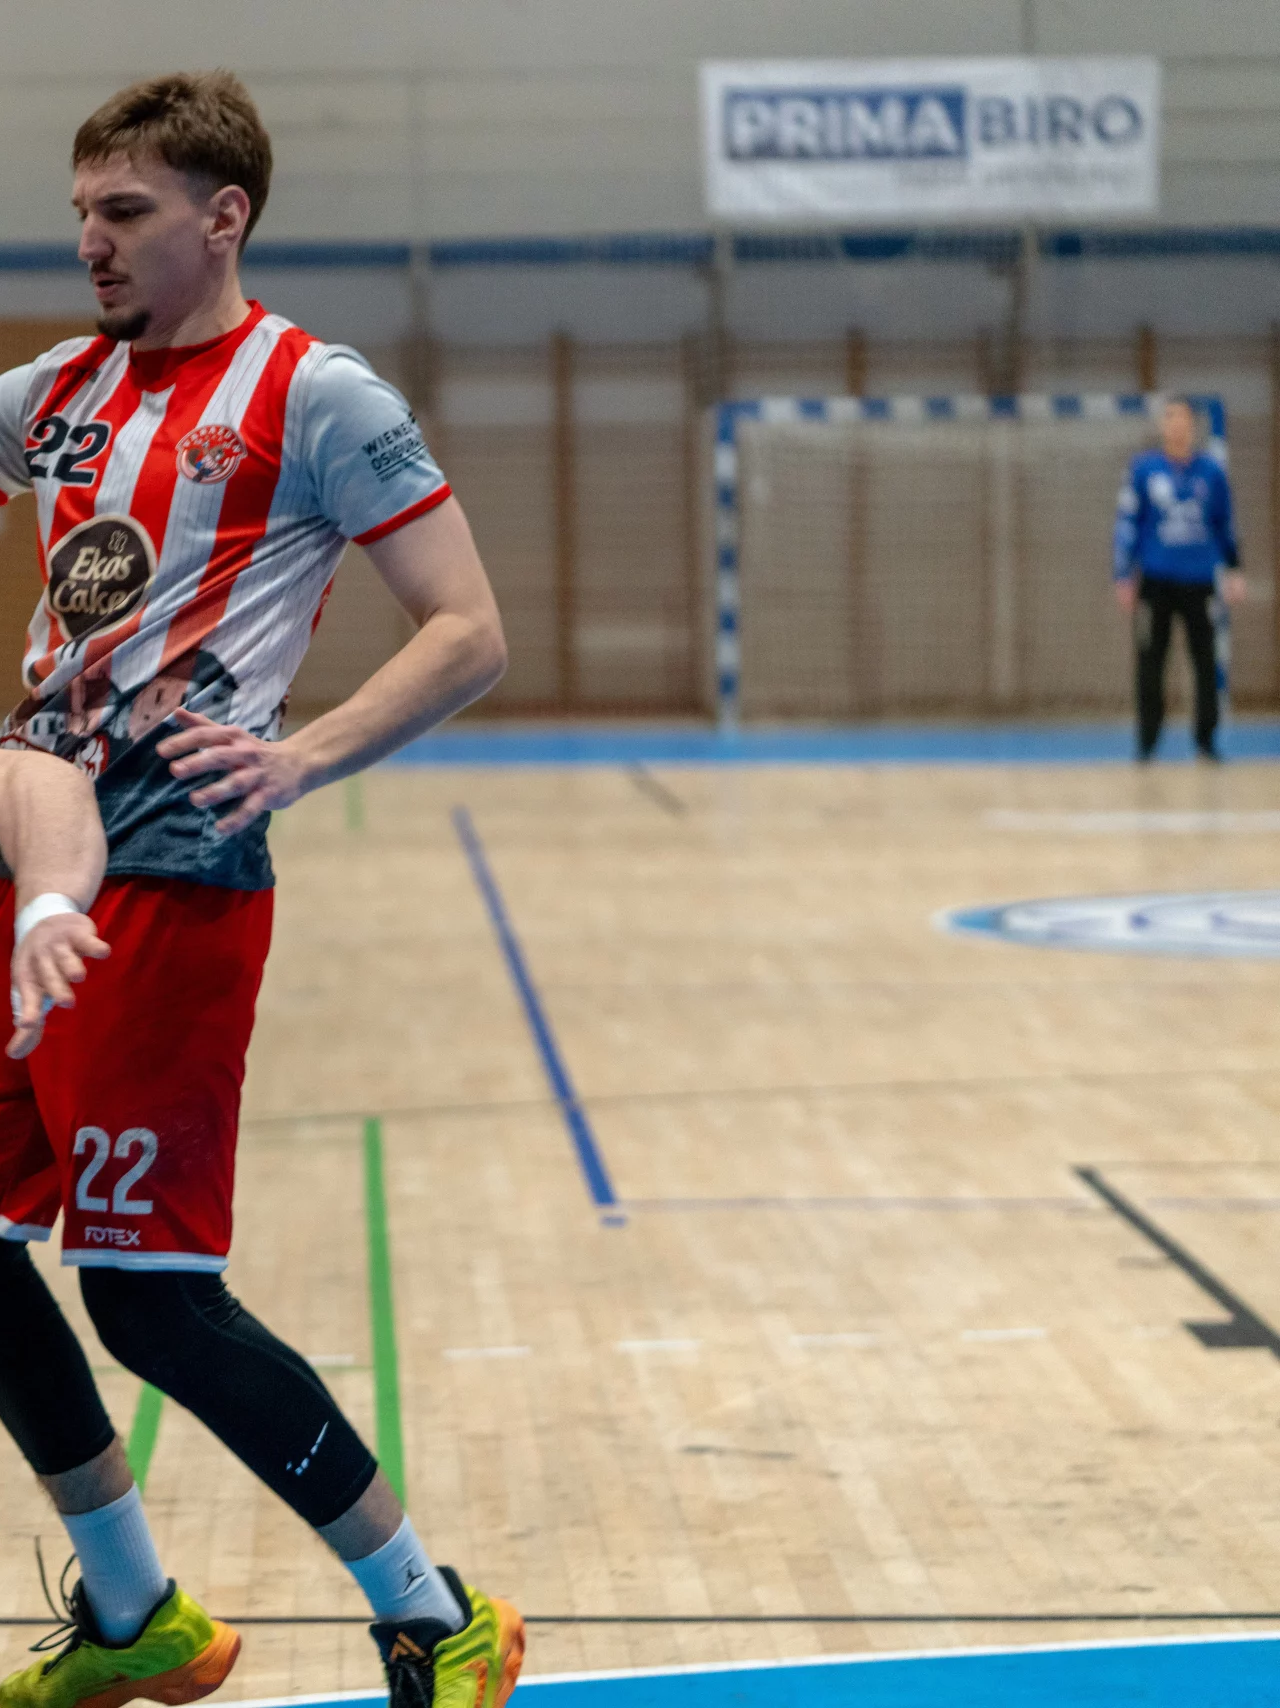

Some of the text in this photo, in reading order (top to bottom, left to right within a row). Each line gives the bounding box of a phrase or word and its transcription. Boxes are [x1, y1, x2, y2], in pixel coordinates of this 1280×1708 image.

[977, 94, 1144, 148] BIRO
[24, 412, 112, 488] 22
[73, 1126, 159, 1215] 22
